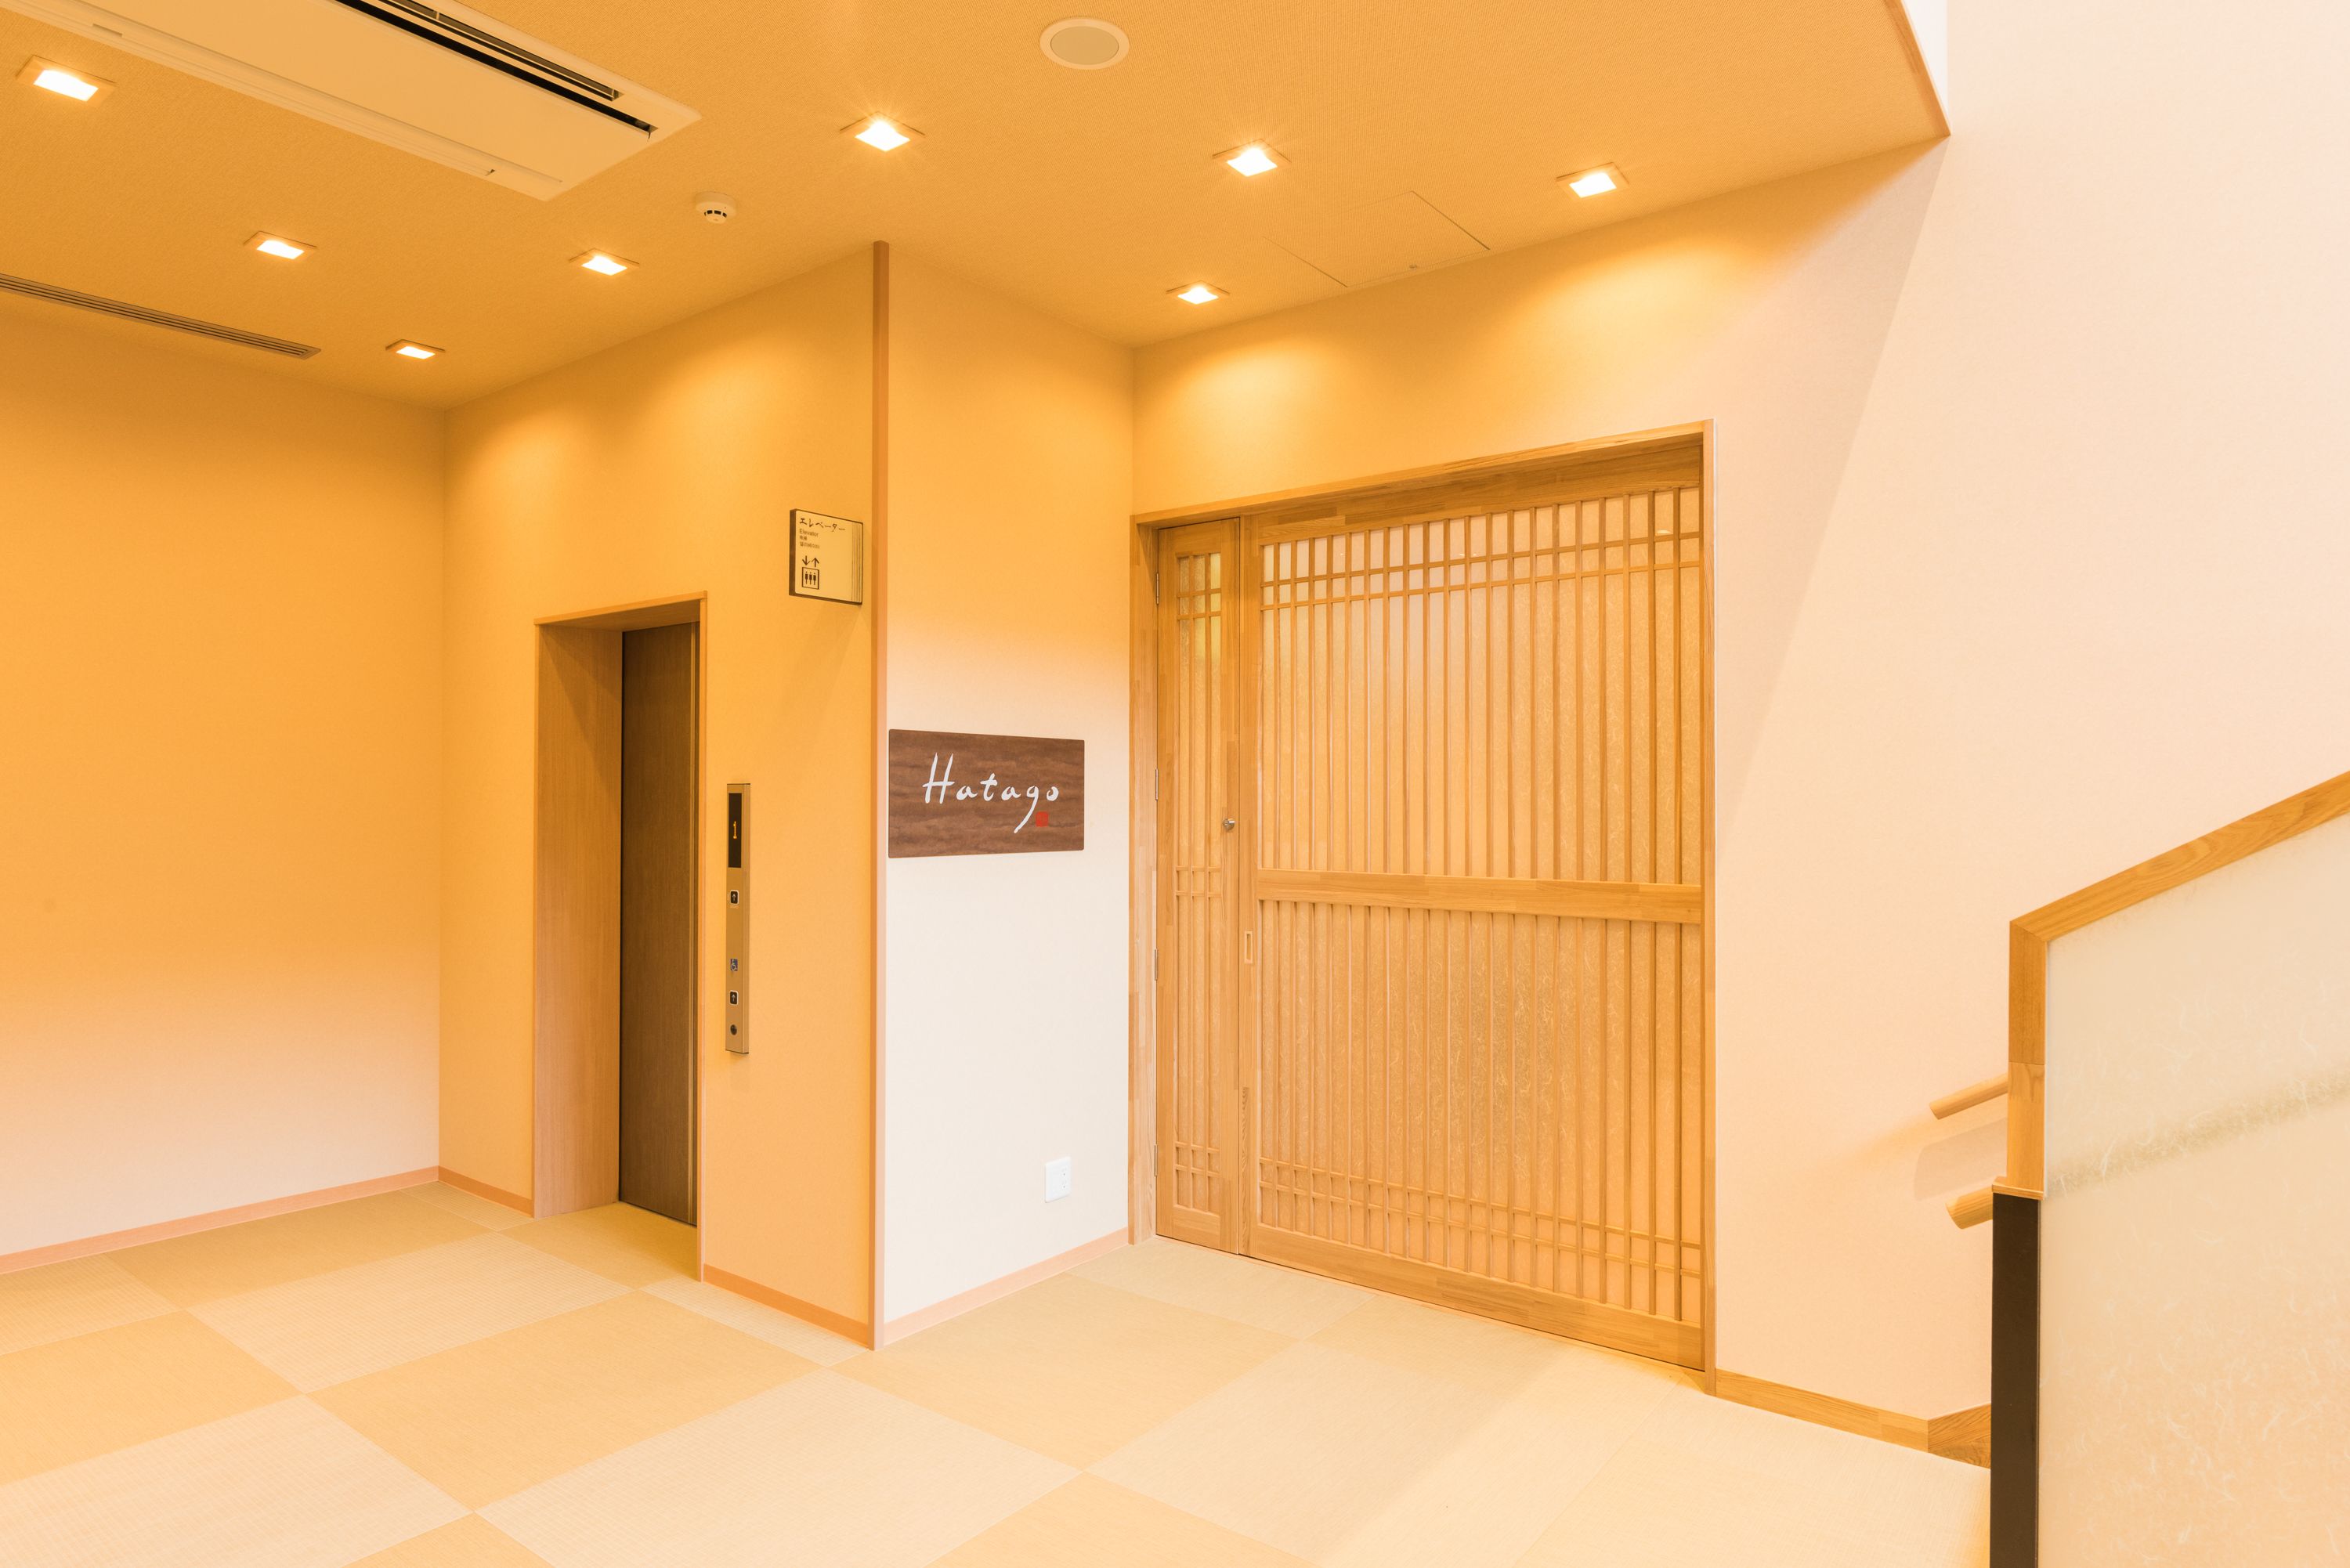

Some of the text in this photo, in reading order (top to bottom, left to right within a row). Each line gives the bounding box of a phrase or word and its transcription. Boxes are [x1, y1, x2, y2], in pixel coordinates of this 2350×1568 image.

[799, 528, 819, 537] Elevator
[800, 518, 846, 533] エレベーター
[922, 752, 1059, 834] Hatago
[732, 821, 738, 840] 1
